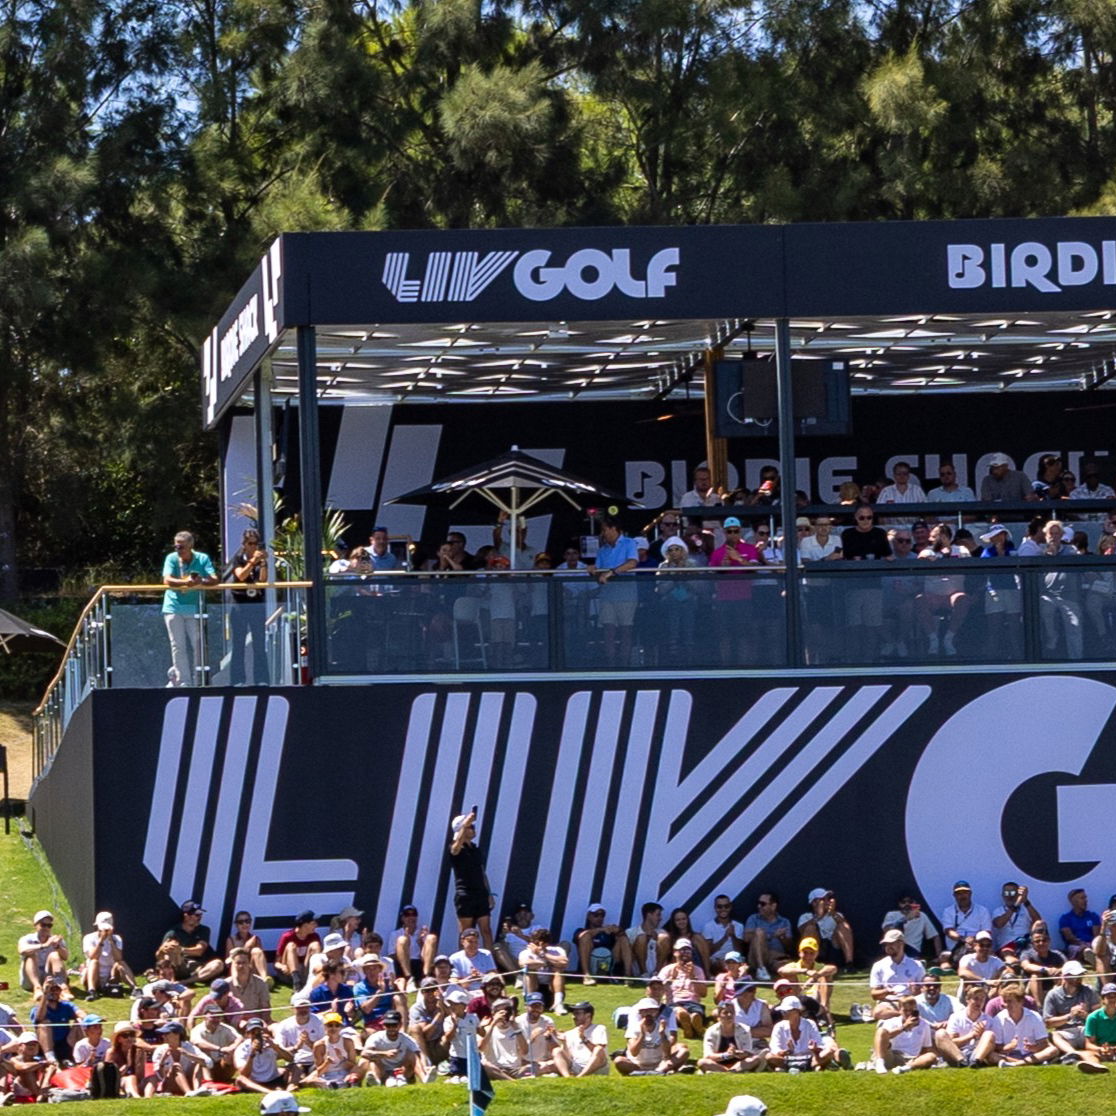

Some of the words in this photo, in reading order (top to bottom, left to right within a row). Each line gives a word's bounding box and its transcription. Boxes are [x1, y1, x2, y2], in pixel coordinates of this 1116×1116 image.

[381, 250, 520, 303] LIV
[513, 248, 680, 302] GOLF
[142, 684, 933, 966] LIV
